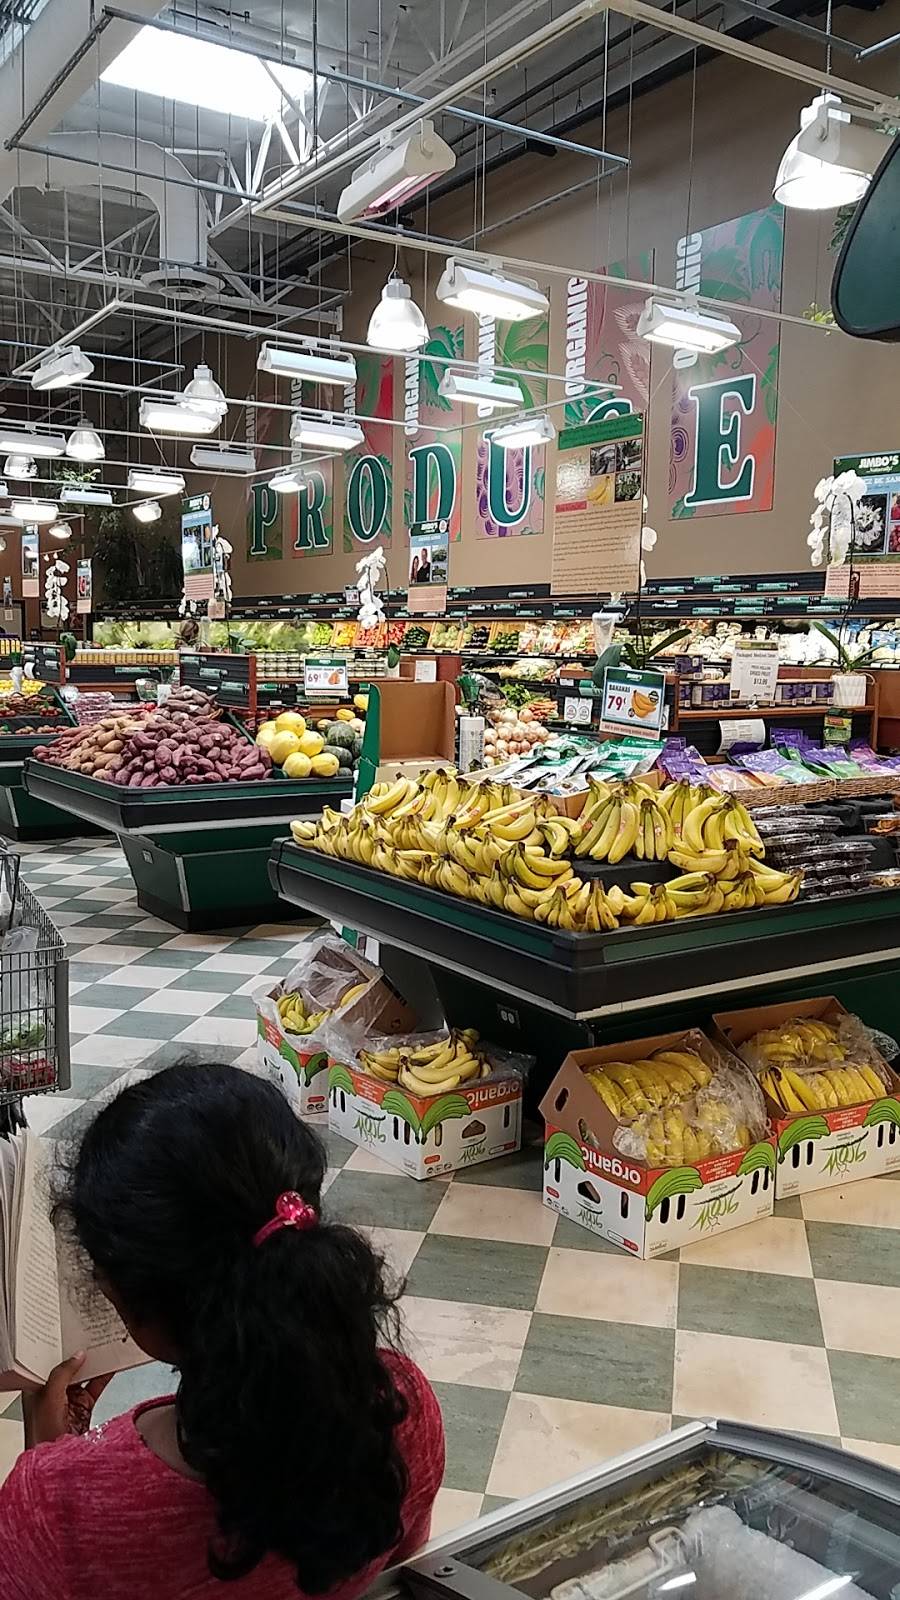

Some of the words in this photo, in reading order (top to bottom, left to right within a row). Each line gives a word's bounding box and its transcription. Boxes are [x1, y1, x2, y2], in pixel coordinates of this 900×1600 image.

[564, 277, 589, 396] ORGANIC
[858, 455, 899, 469] JIMBO'S
[608, 684, 631, 694] BANANAS
[582, 1146, 642, 1185] organic
